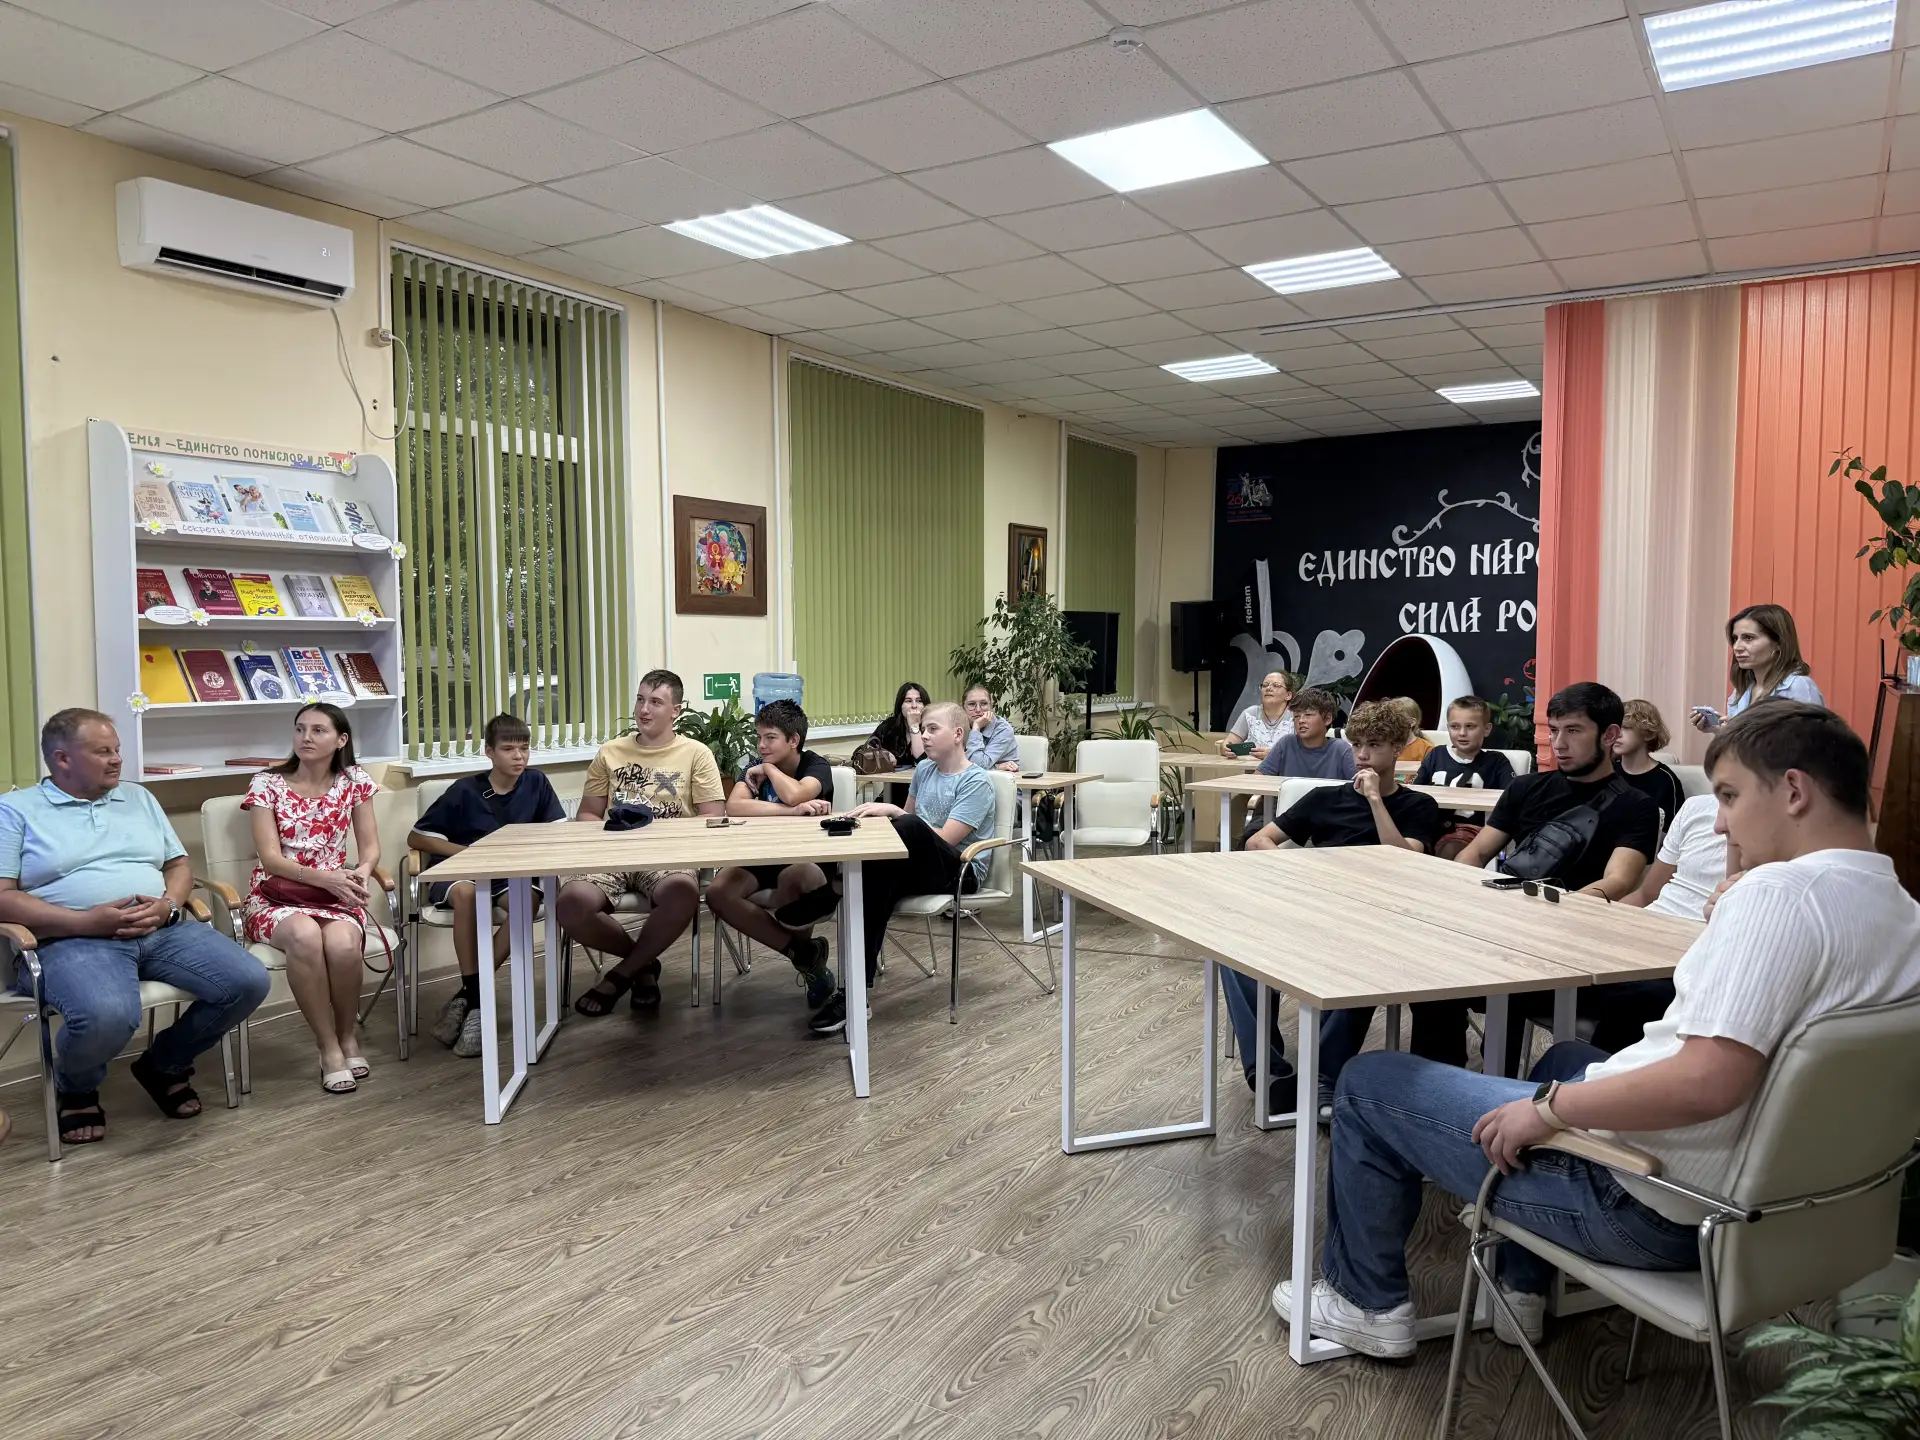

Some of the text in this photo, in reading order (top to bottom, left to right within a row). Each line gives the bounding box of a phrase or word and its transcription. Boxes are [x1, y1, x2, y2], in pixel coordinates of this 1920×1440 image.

[127, 432, 160, 447] ЕМЬЯ
[243, 447, 303, 464] ПОМЫСЛОВ
[316, 455, 342, 470] ДЕЛ
[182, 525, 348, 543] секреты гармоничных отношений
[1298, 545, 1456, 587] ЕДИНСТВО
[1244, 585, 1253, 624] Rekam
[1398, 597, 1482, 633] СИЛА
